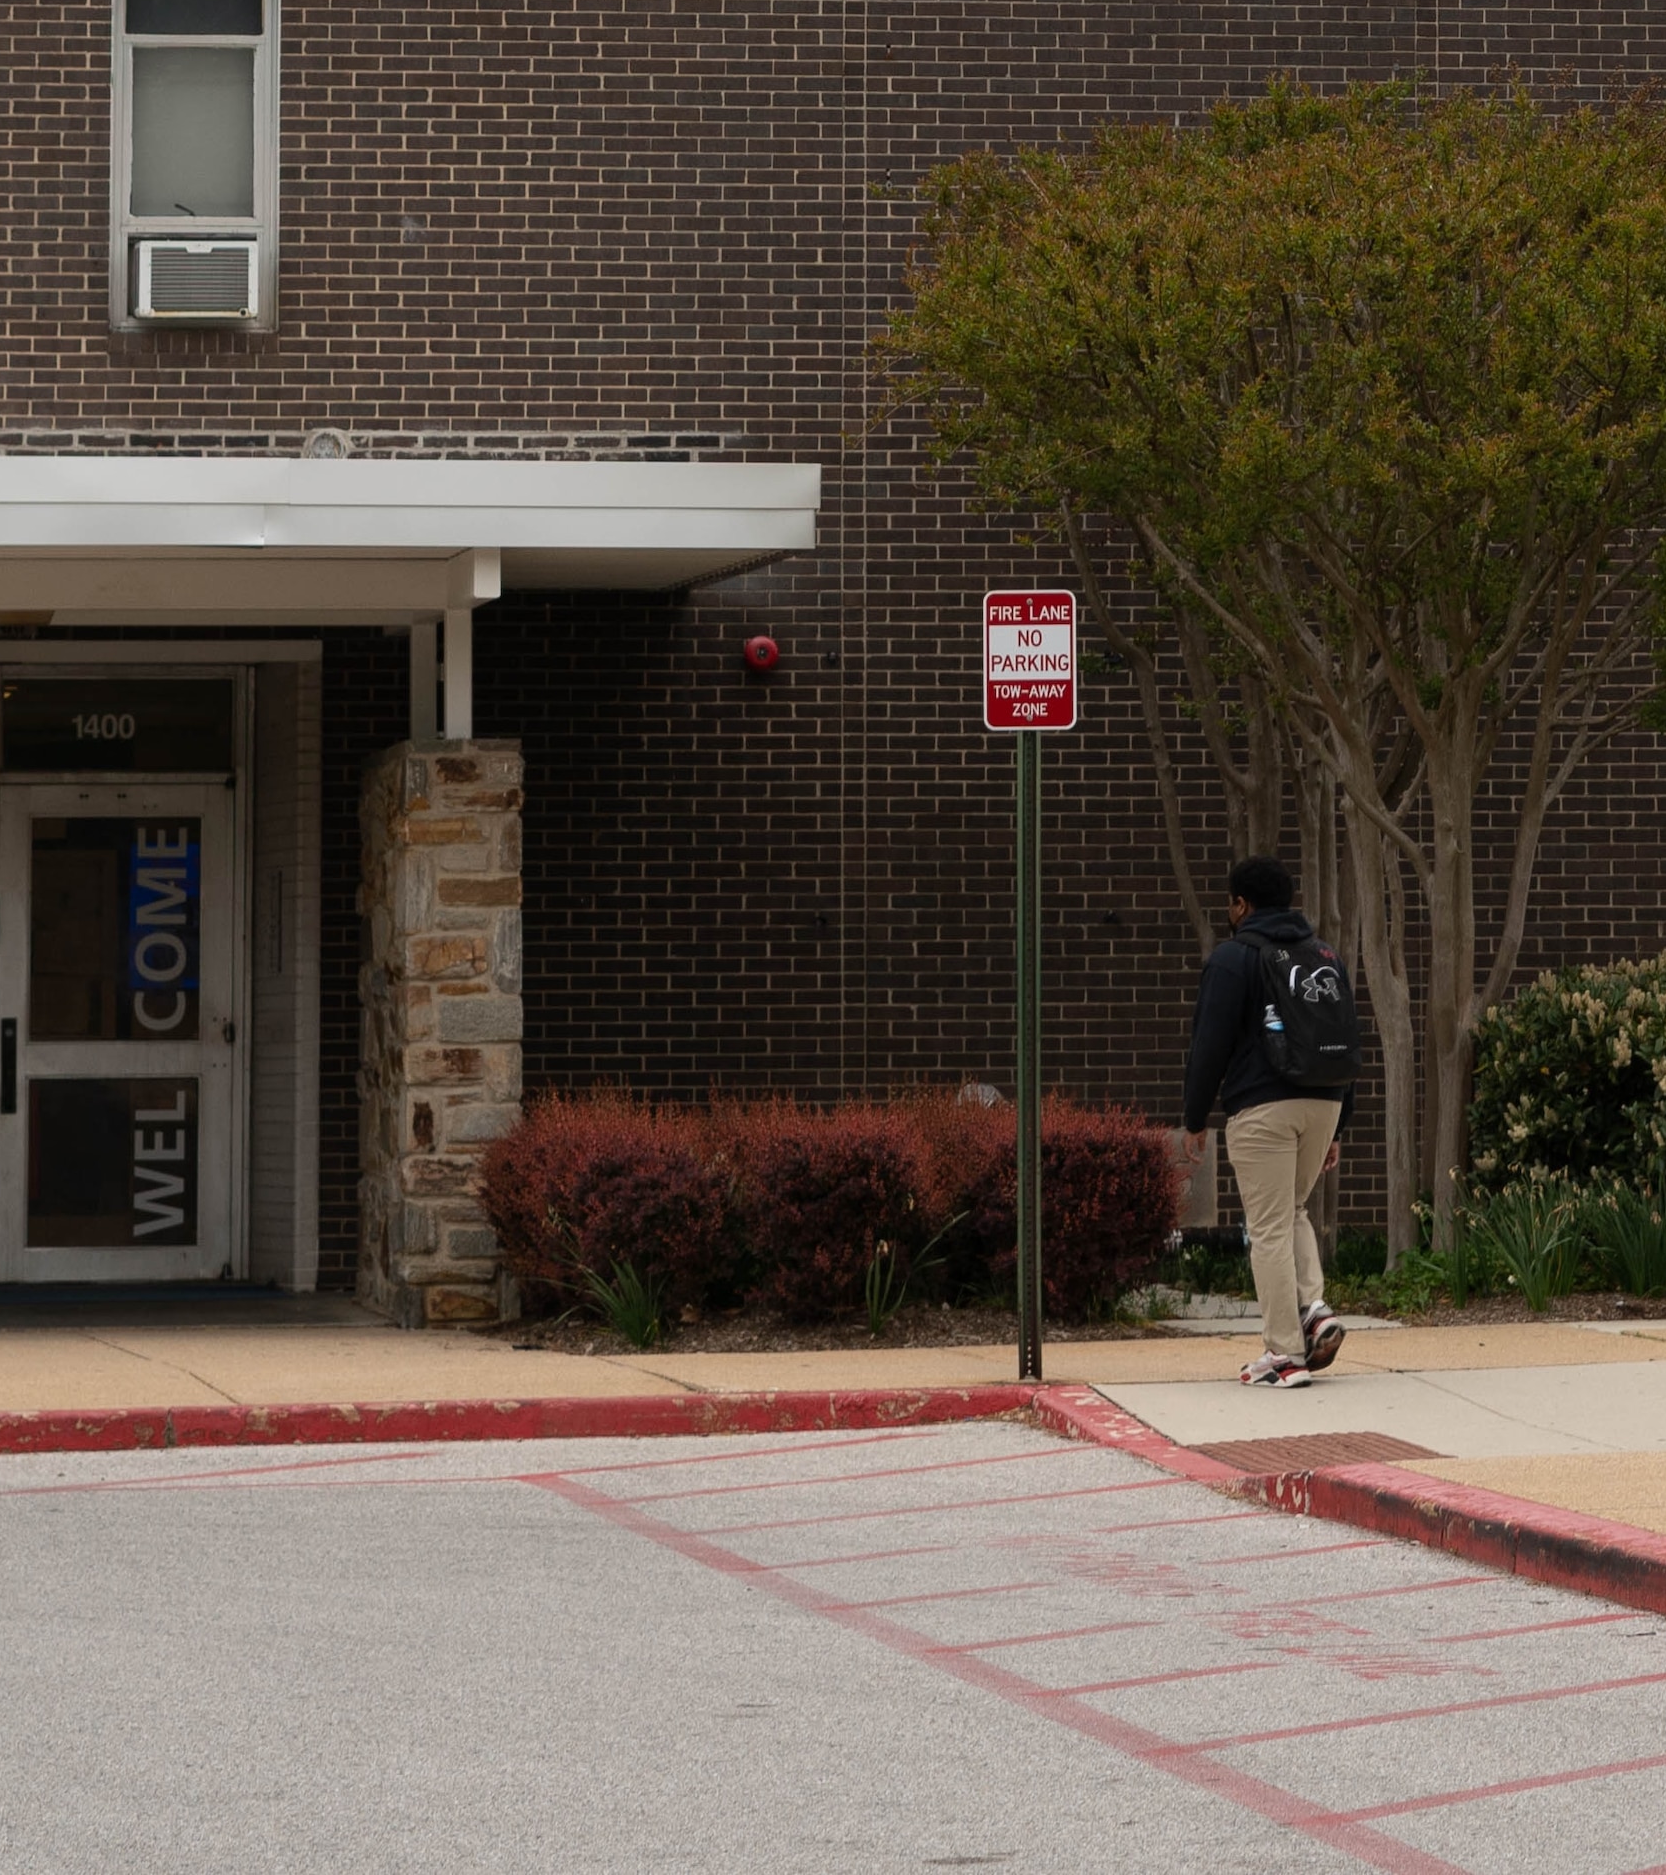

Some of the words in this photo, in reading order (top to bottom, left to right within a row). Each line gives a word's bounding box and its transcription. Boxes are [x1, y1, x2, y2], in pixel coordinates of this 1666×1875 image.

[989, 606, 1022, 621] FIRE
[1029, 605, 1070, 620] LANE
[1017, 629, 1042, 647] NO
[991, 654, 1070, 672] PARKING
[993, 684, 1066, 698] TOW-AWAY
[1012, 702, 1048, 717] ZONE
[71, 713, 136, 740] 1400
[134, 826, 188, 1032] COME
[133, 1089, 186, 1238] WEL
